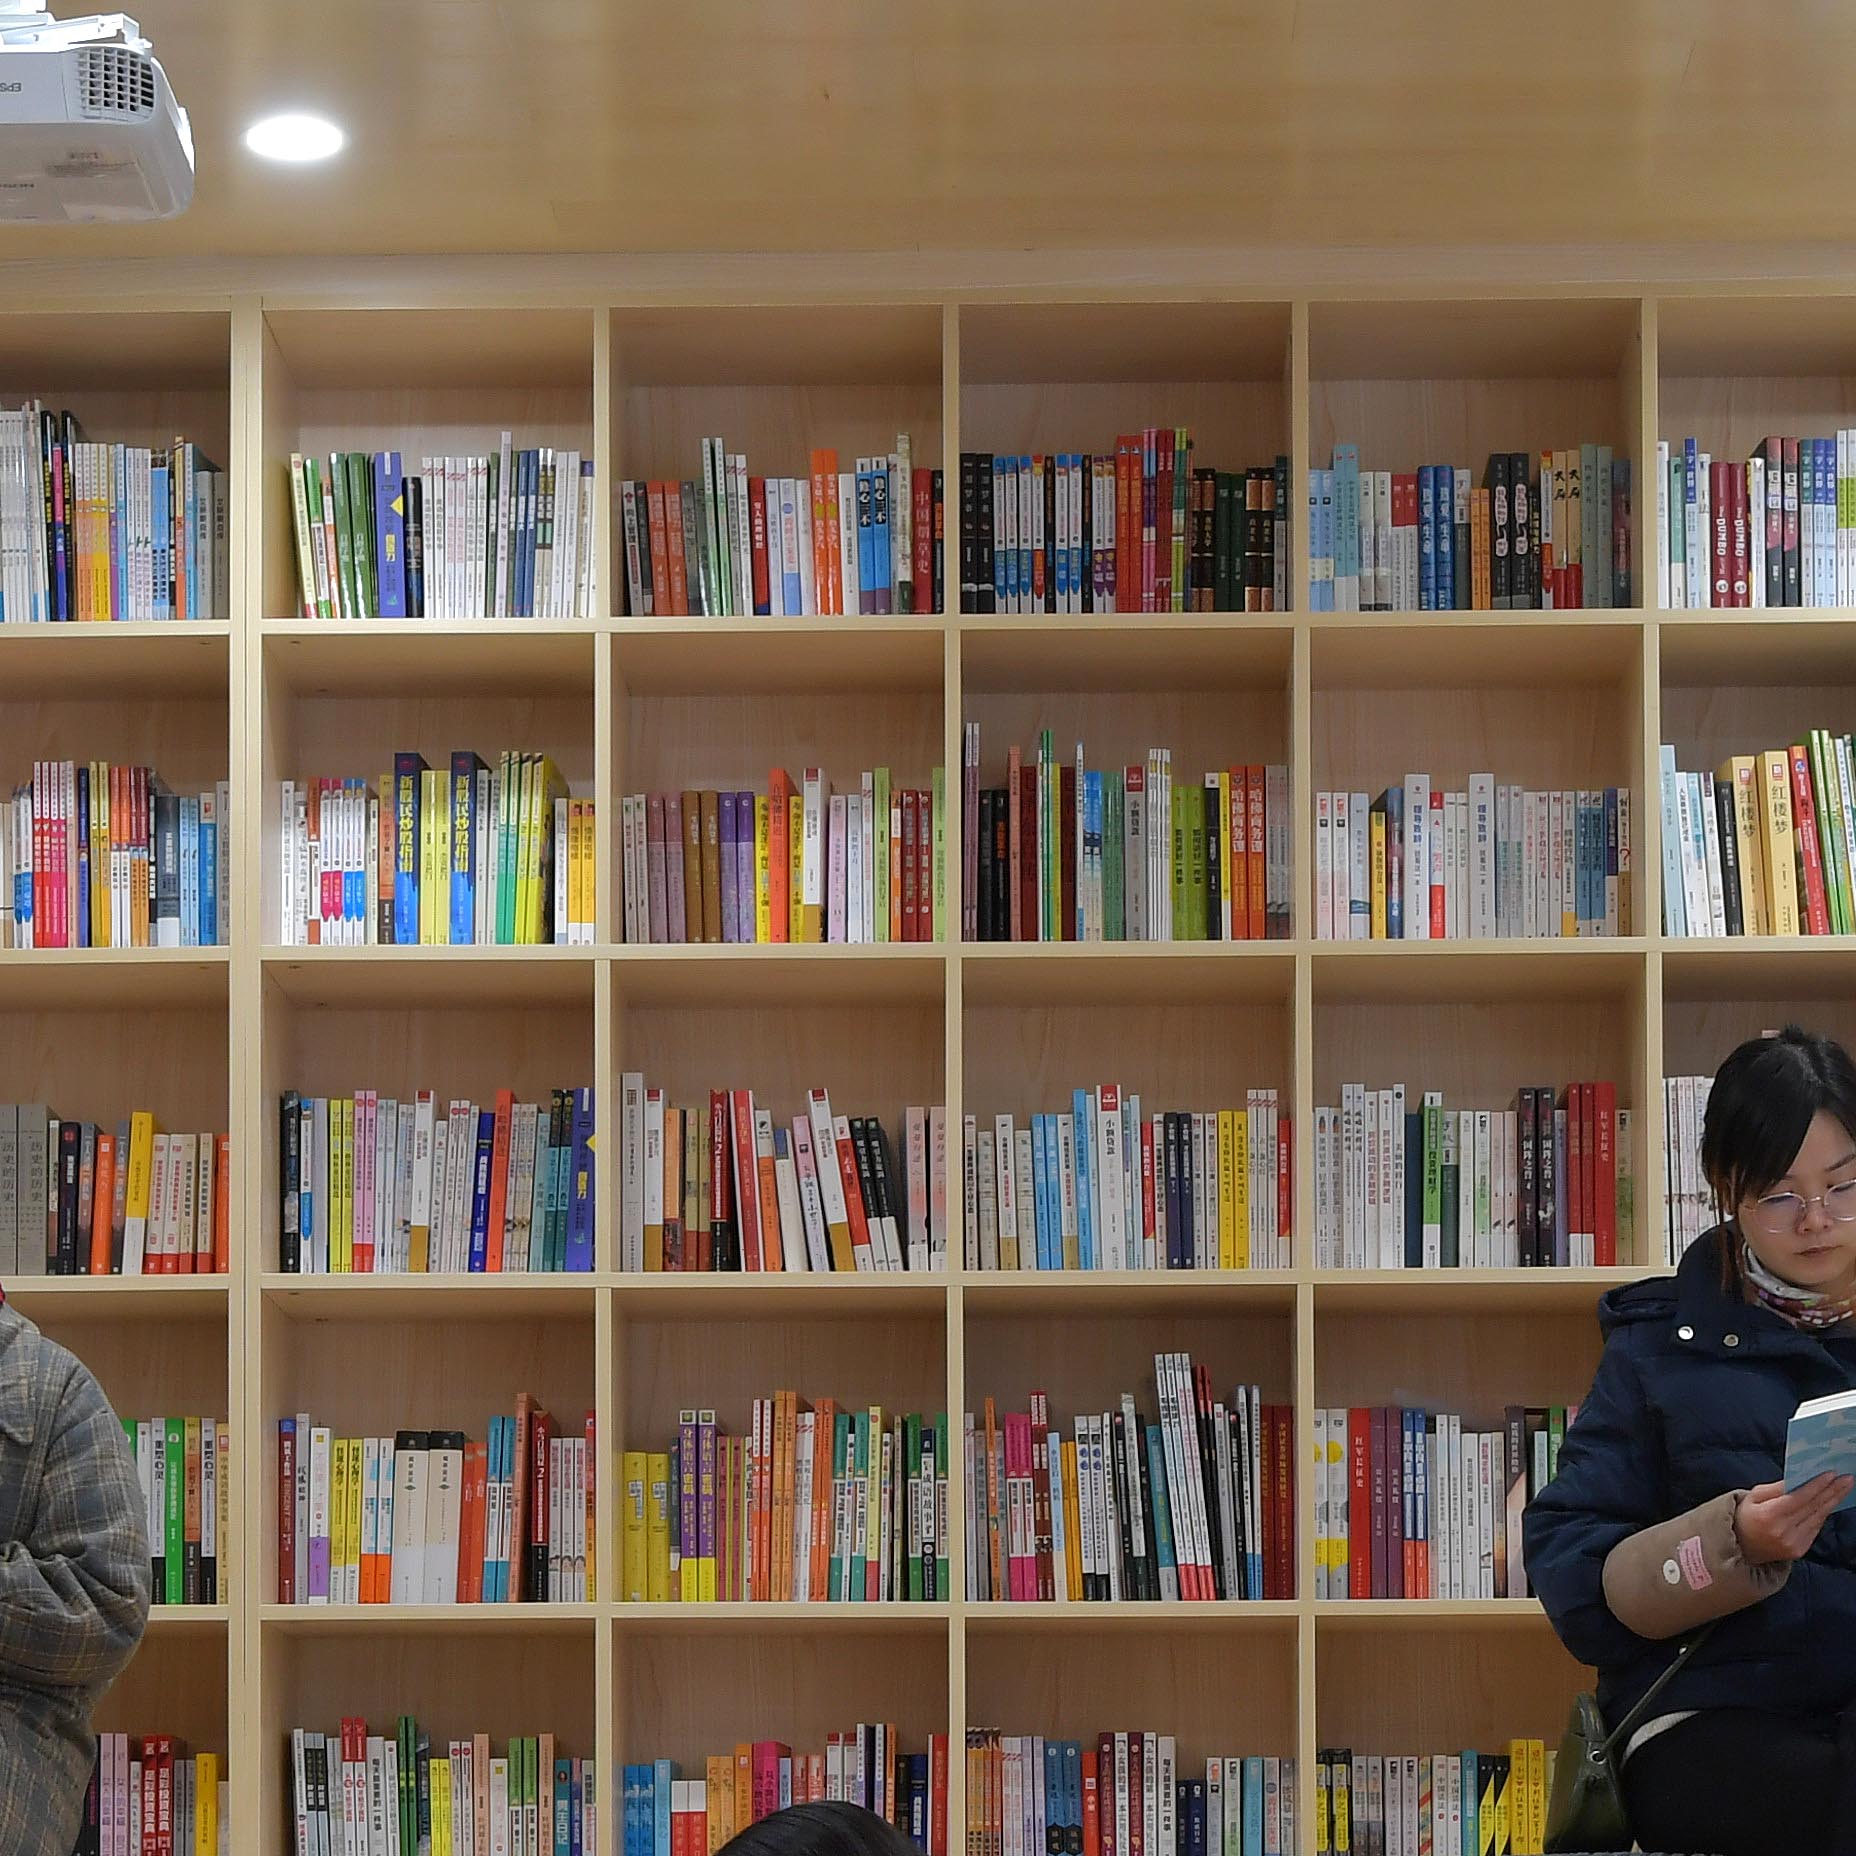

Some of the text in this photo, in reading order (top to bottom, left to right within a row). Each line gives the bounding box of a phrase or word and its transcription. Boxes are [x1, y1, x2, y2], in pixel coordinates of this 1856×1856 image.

[1739, 790, 1756, 839] 红楼梦
[1772, 785, 1789, 836] 红楼梦
